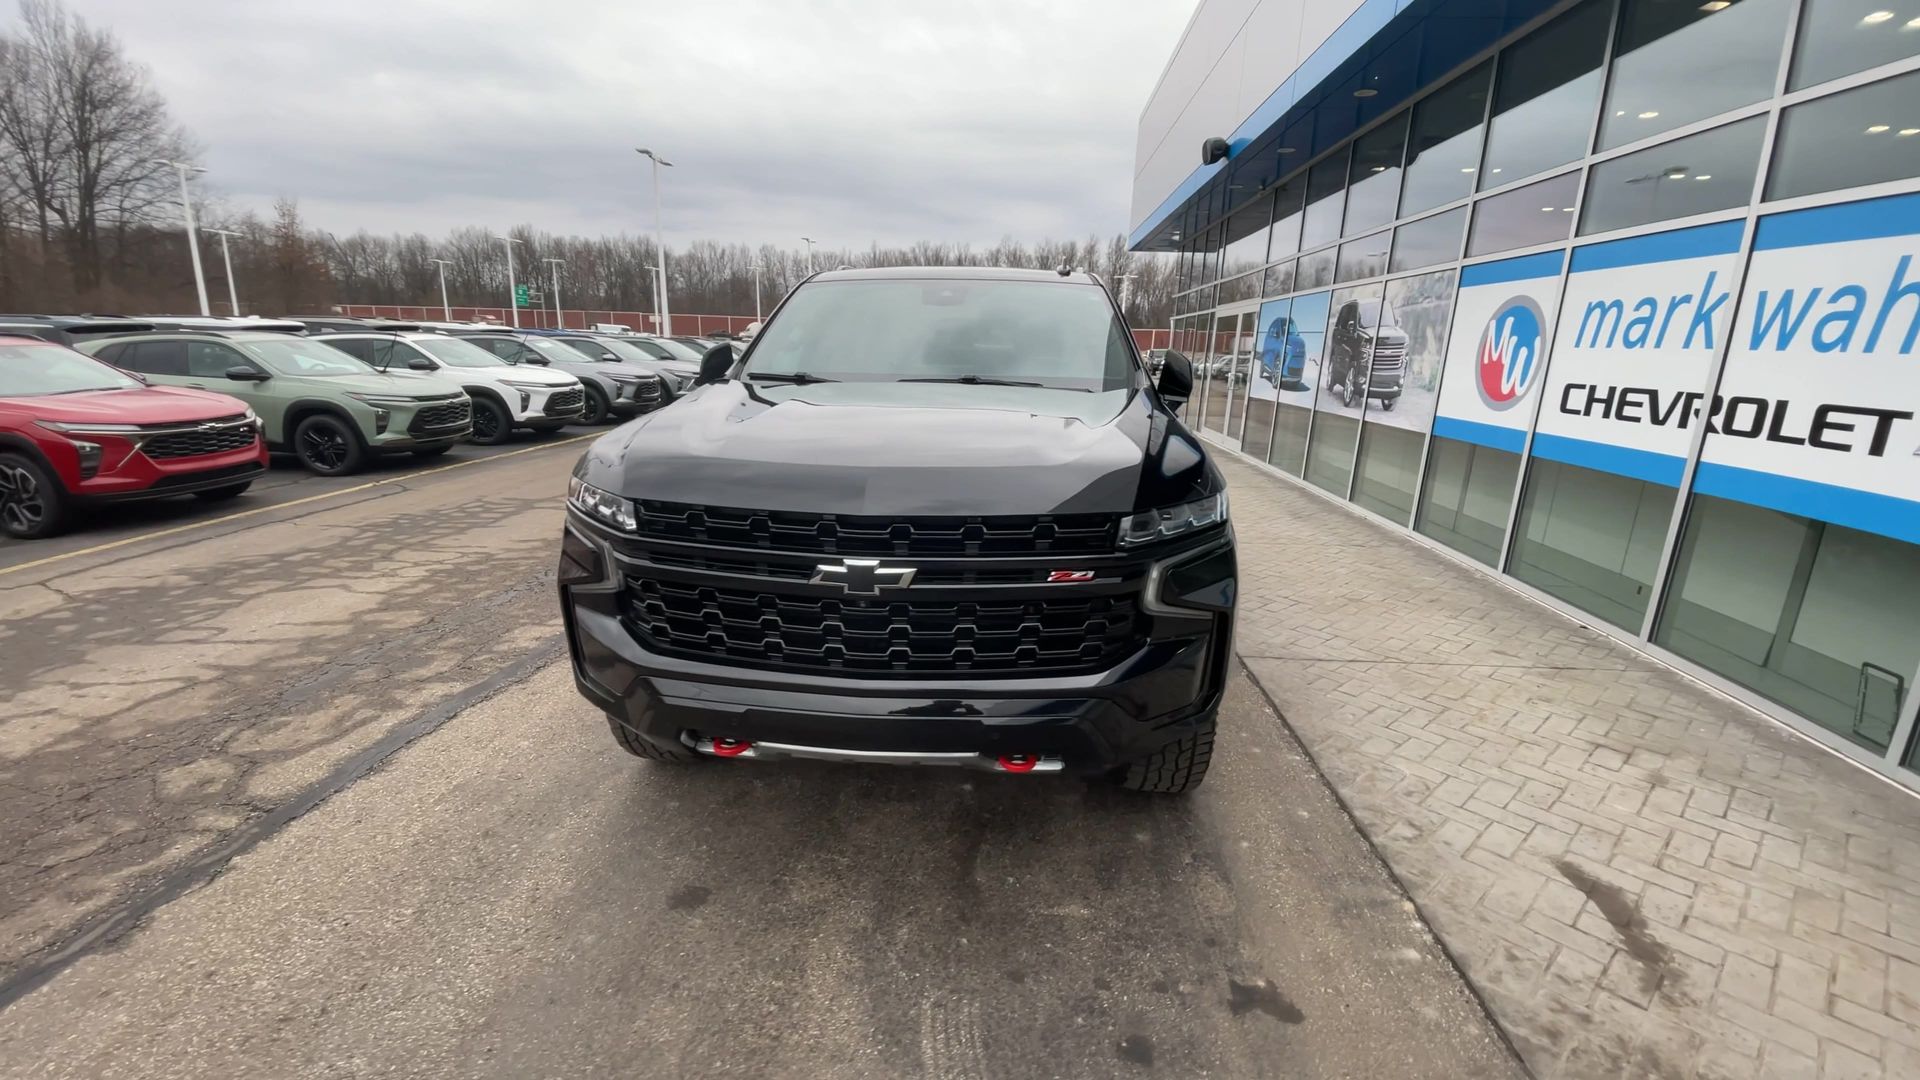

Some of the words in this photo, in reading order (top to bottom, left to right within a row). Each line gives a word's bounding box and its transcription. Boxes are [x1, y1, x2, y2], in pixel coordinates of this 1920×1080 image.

[1574, 271, 1730, 350] mark
[1749, 254, 1920, 355] wah
[1559, 383, 1914, 457] CHEVROLET
